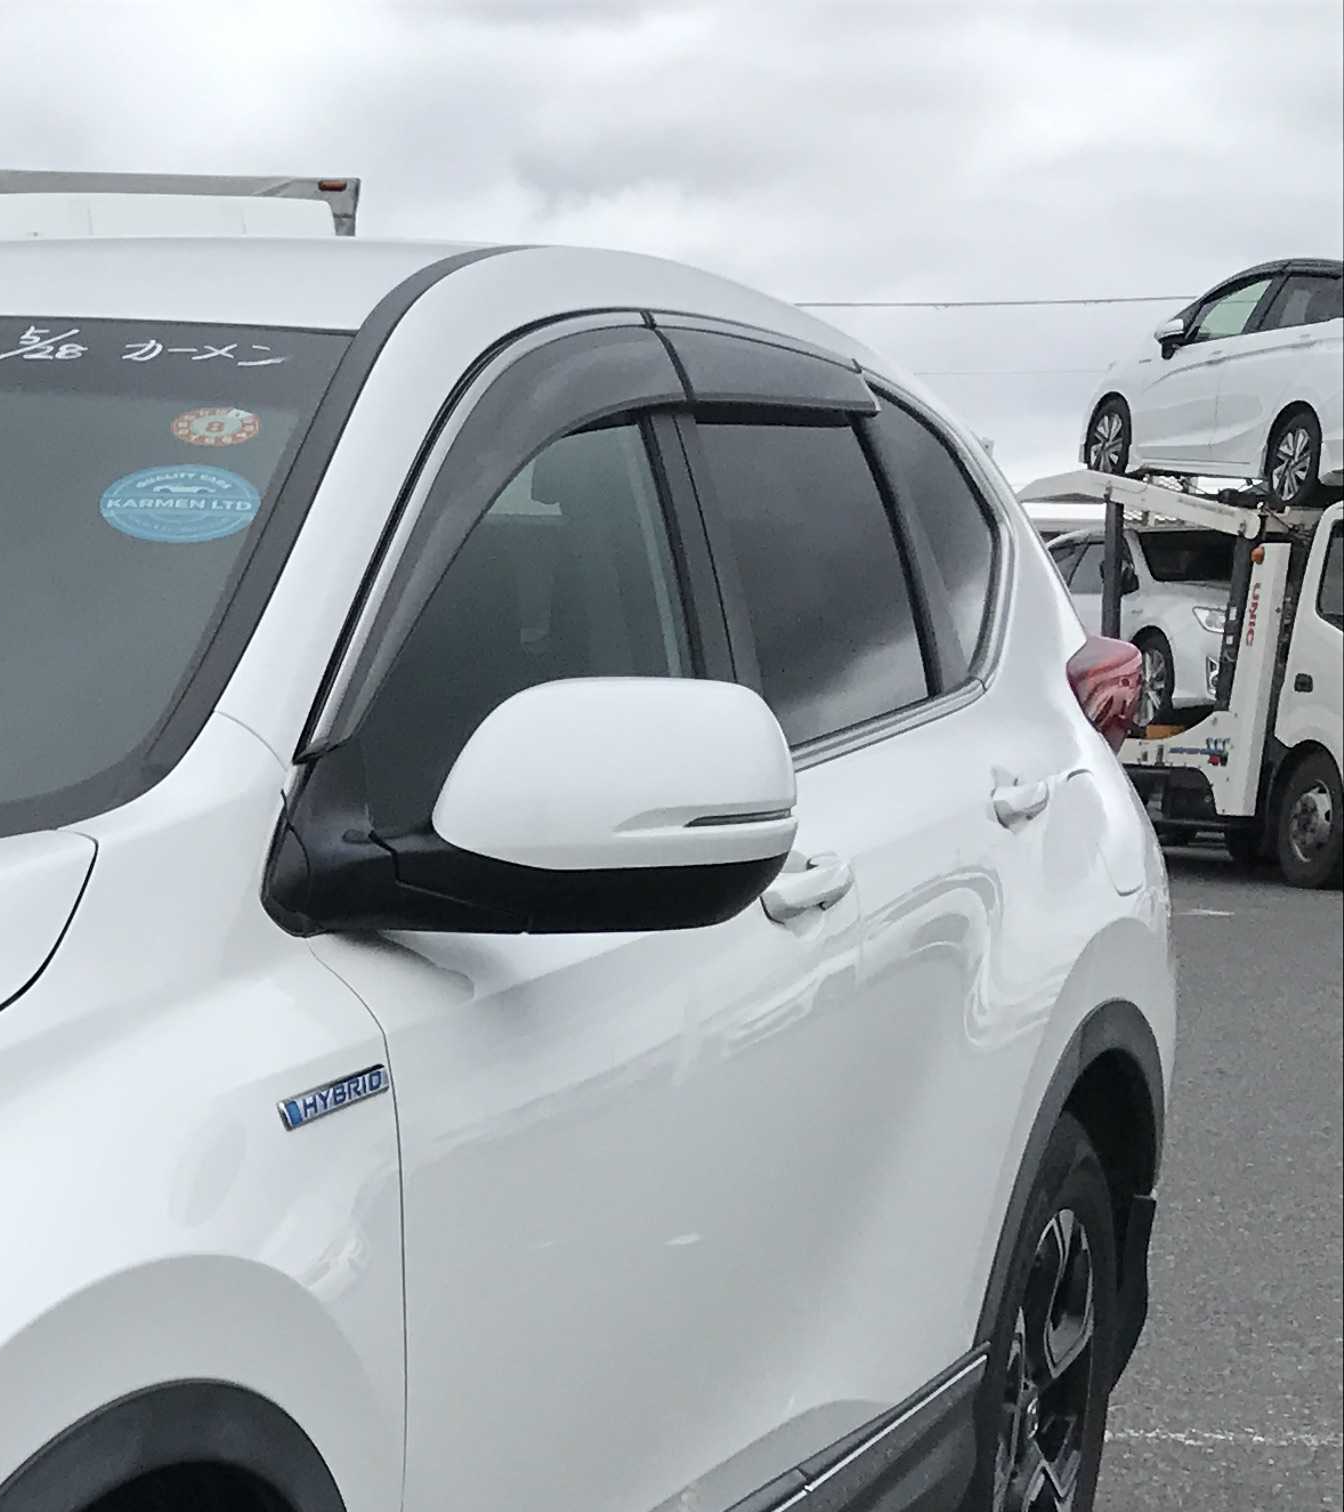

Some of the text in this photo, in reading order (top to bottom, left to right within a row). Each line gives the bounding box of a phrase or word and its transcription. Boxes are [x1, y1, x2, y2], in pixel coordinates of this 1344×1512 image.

[107, 497, 253, 512] KARMEN LTD
[302, 1070, 382, 1118] HYBRID
